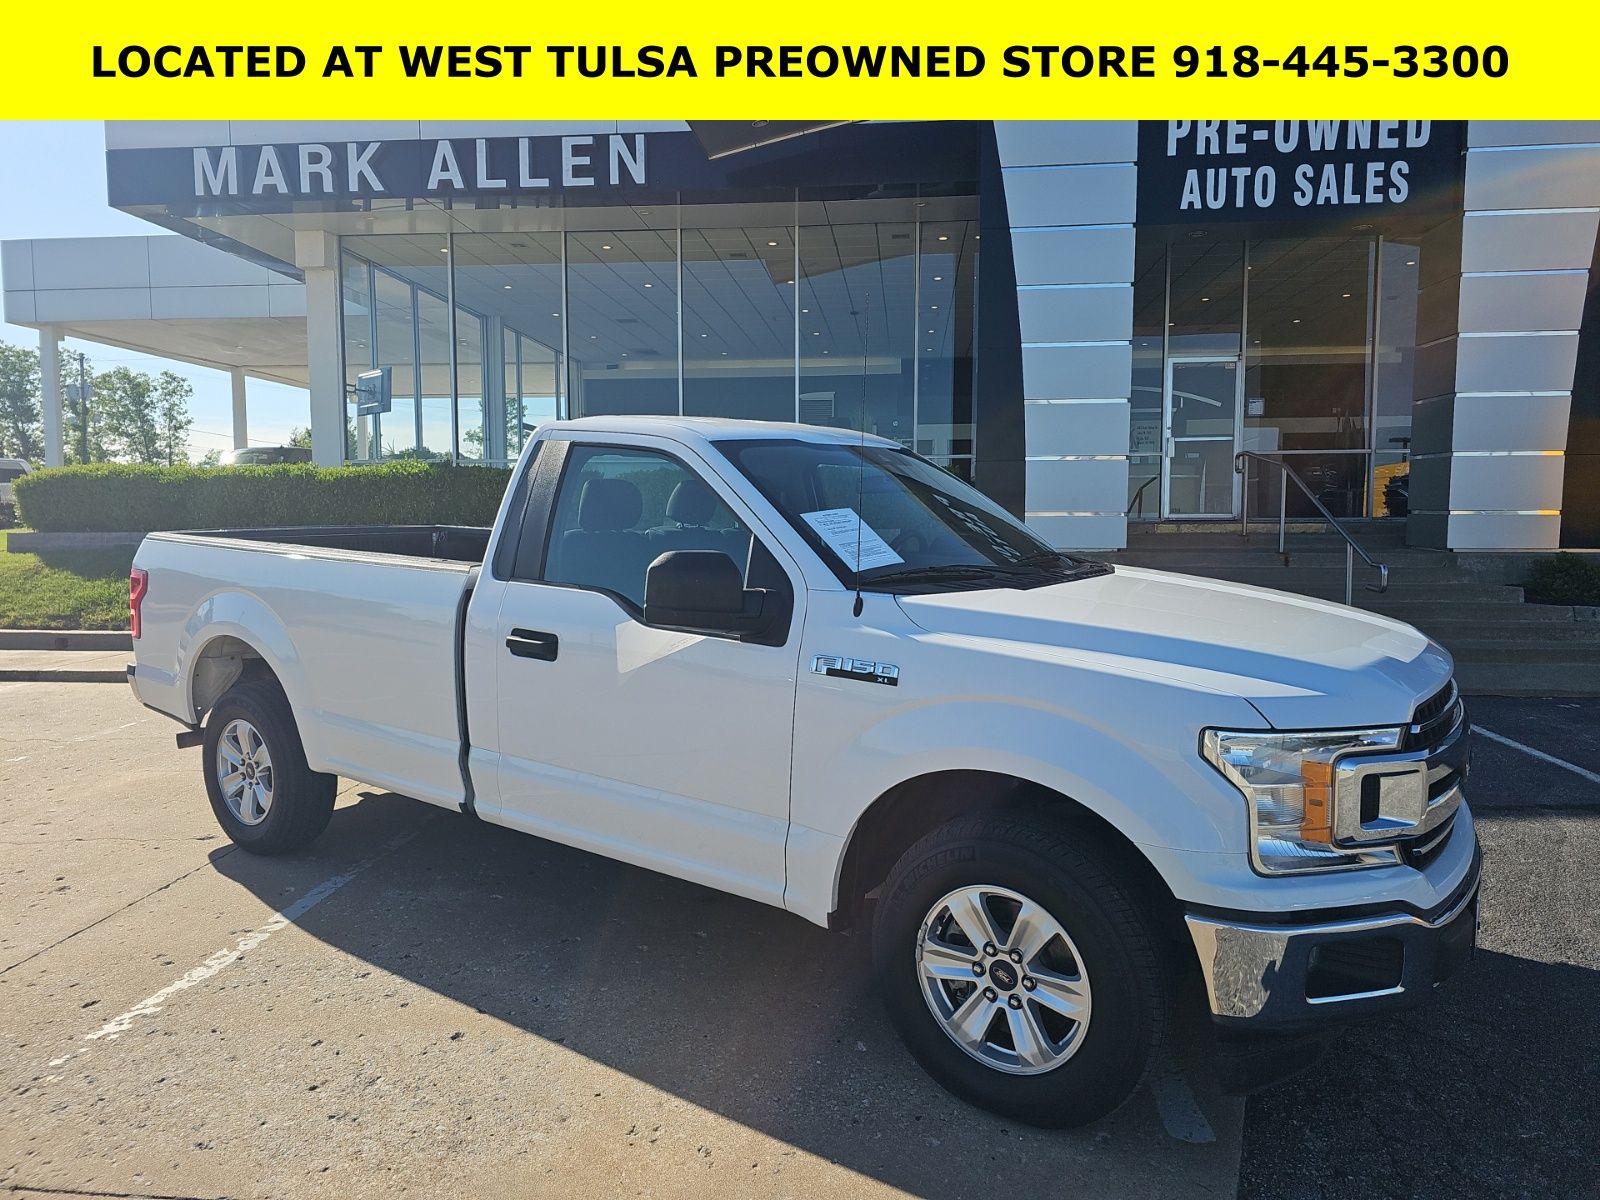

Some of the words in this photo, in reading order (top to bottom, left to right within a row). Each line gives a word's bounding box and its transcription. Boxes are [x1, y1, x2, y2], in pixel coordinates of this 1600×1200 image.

[1166, 120, 1432, 156] PRE-OWNED
[193, 142, 386, 197] MARK
[426, 133, 647, 190] ALLEN
[1179, 165, 1276, 210] AUTO
[1292, 160, 1410, 207] SALES
[877, 676, 889, 684] XL
